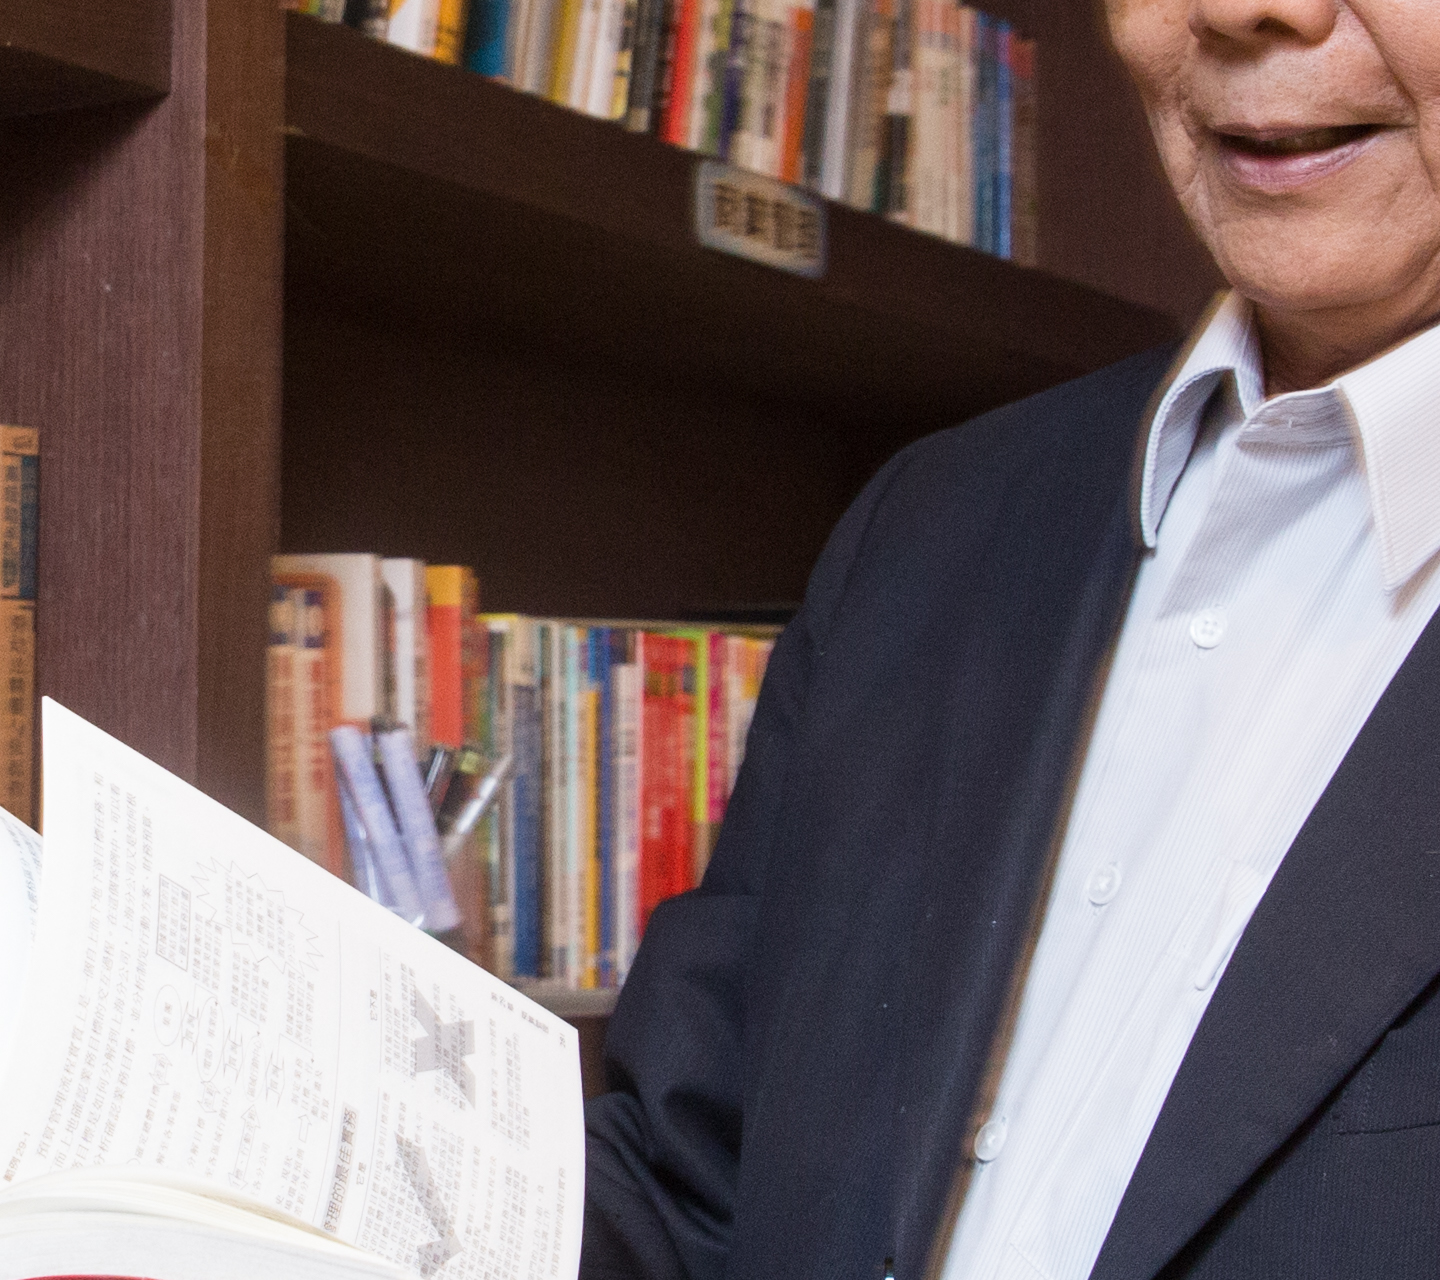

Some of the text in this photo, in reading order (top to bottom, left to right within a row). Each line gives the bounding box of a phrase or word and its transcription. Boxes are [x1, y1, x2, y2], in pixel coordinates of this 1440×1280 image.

[185, 1116, 207, 1167] 分解目標
[353, 1161, 368, 1186] 它是
